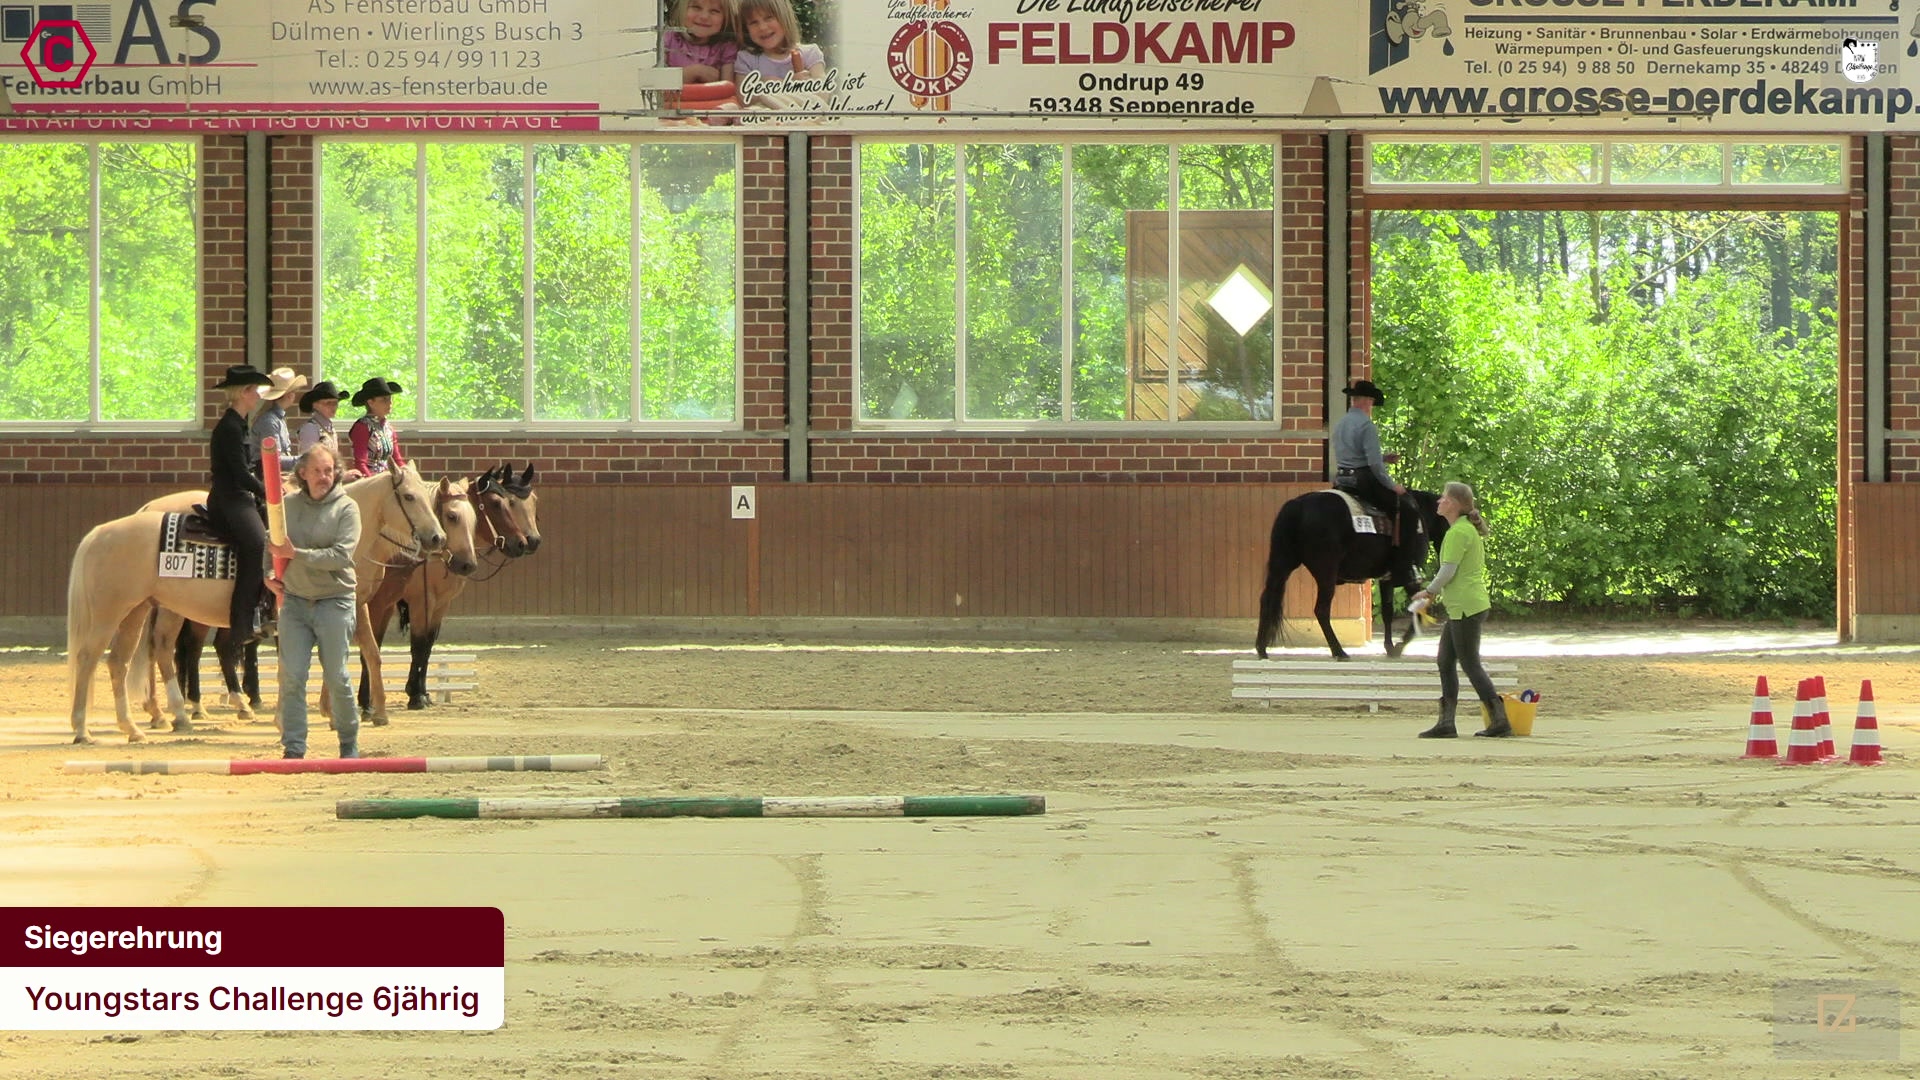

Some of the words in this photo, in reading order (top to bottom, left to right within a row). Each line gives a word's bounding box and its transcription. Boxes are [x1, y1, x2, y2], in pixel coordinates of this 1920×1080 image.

[307, 0, 336, 14] AS
[344, 0, 470, 14] Fensterbau
[479, 0, 548, 14] GmbH
[888, 5, 975, 24] Landfleischerei
[113, 0, 221, 64] AS
[272, 21, 360, 41] Dülmen
[381, 21, 486, 46] Wierlings
[495, 21, 562, 41] Busch
[571, 22, 584, 41] 3
[1465, 27, 1523, 42] Heizung
[1536, 26, 1587, 40] Sanitär
[1600, 27, 1686, 40] Brunnenbau
[1700, 28, 1738, 40] Solar
[1751, 27, 1899, 42] Erdwärmebohrungen
[988, 22, 1297, 65] FELDKAMP
[1496, 43, 1602, 58] Wärmepumpen
[1617, 41, 1639, 56] Öl-
[1643, 44, 1669, 56] und
[316, 50, 359, 68] Tel.:
[1464, 60, 1493, 75] Tel.
[1647, 61, 1741, 77] Dernekamp
[1746, 60, 1766, 75] 35
[1781, 60, 1829, 75] 48249
[889, 50, 971, 95] FELDKAMP
[2, 74, 140, 96] Fensterbau
[148, 74, 222, 96] GmbH
[309, 75, 549, 96] www.as-fensterbau.de
[741, 69, 838, 103] Geschmack
[841, 71, 867, 92] ist
[1078, 73, 1169, 95] Ondrup
[1175, 73, 1205, 91] 49
[1029, 97, 1102, 112] 59348
[1109, 97, 1256, 114] Seppenrade
[737, 494, 751, 510] A
[165, 555, 188, 571] 807
